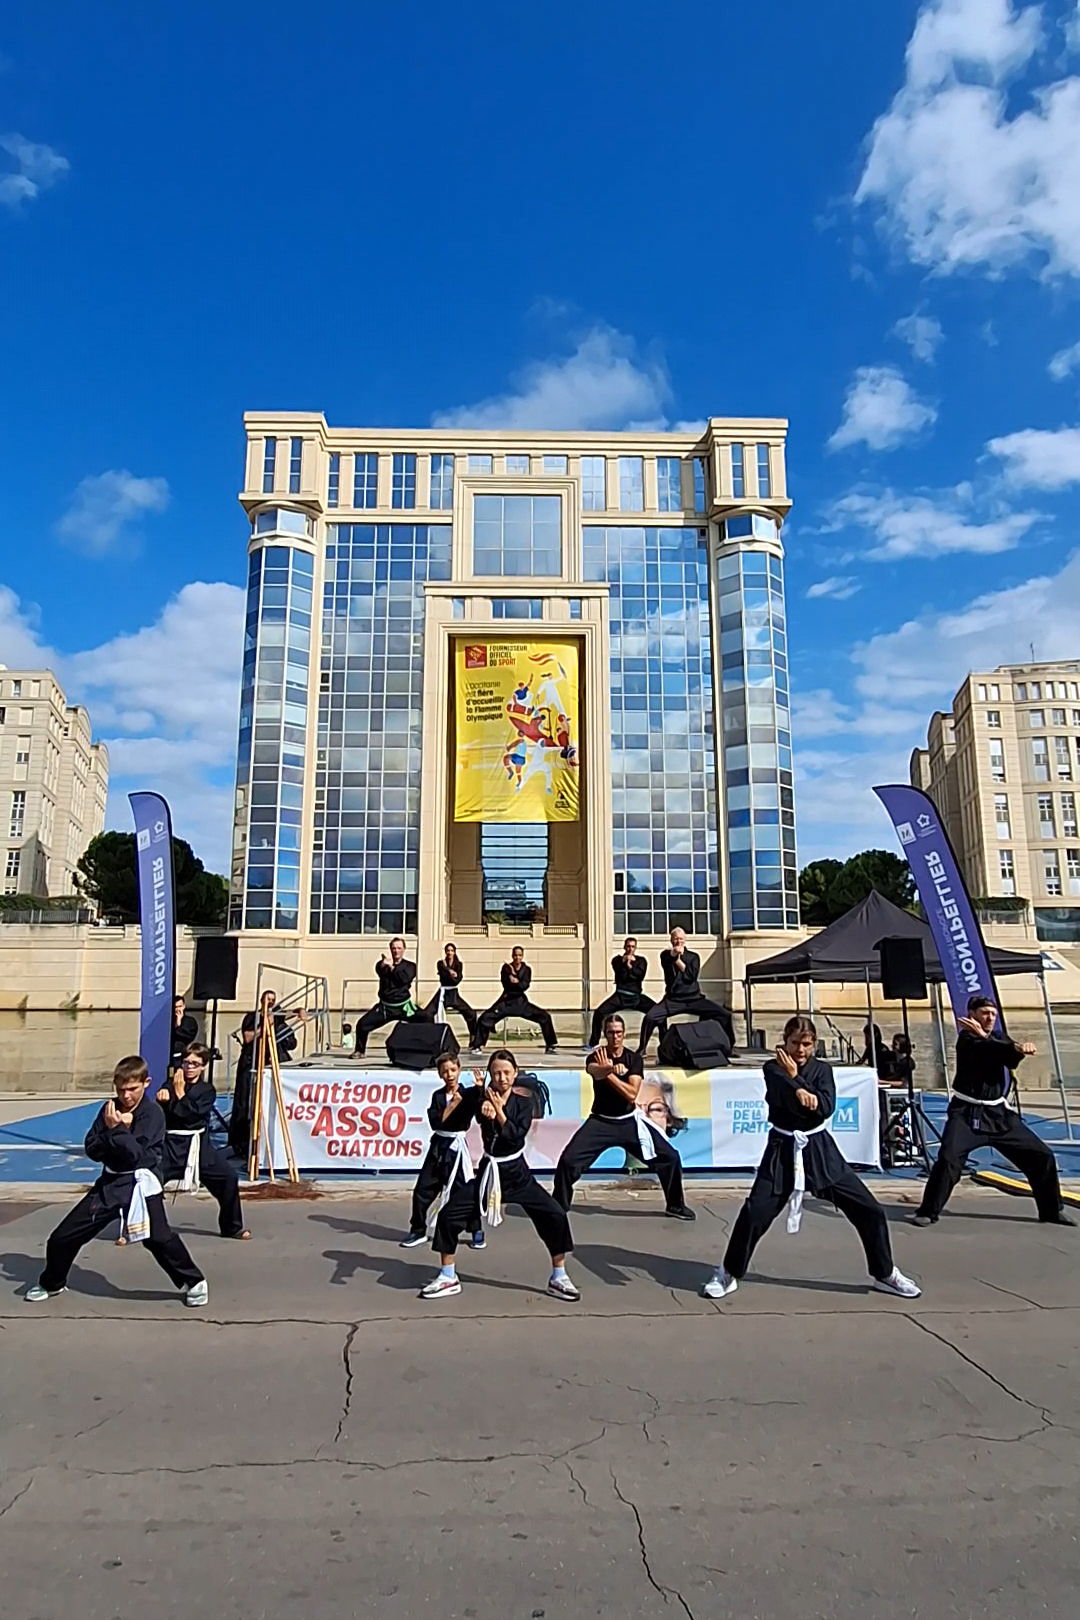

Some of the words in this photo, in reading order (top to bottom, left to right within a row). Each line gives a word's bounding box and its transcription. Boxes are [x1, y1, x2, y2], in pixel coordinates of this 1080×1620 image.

[489, 659, 497, 667] DU
[498, 658, 516, 666] SPORT
[474, 705, 502, 713] Flamme
[466, 713, 503, 723] Olympique
[298, 1081, 412, 1103] antigone
[285, 1103, 317, 1120] des
[733, 1110, 749, 1120] DE
[752, 1110, 762, 1120] LA
[837, 1108, 854, 1123] M
[311, 1106, 423, 1137] ASSO-
[327, 1139, 423, 1157] CIATIONS
